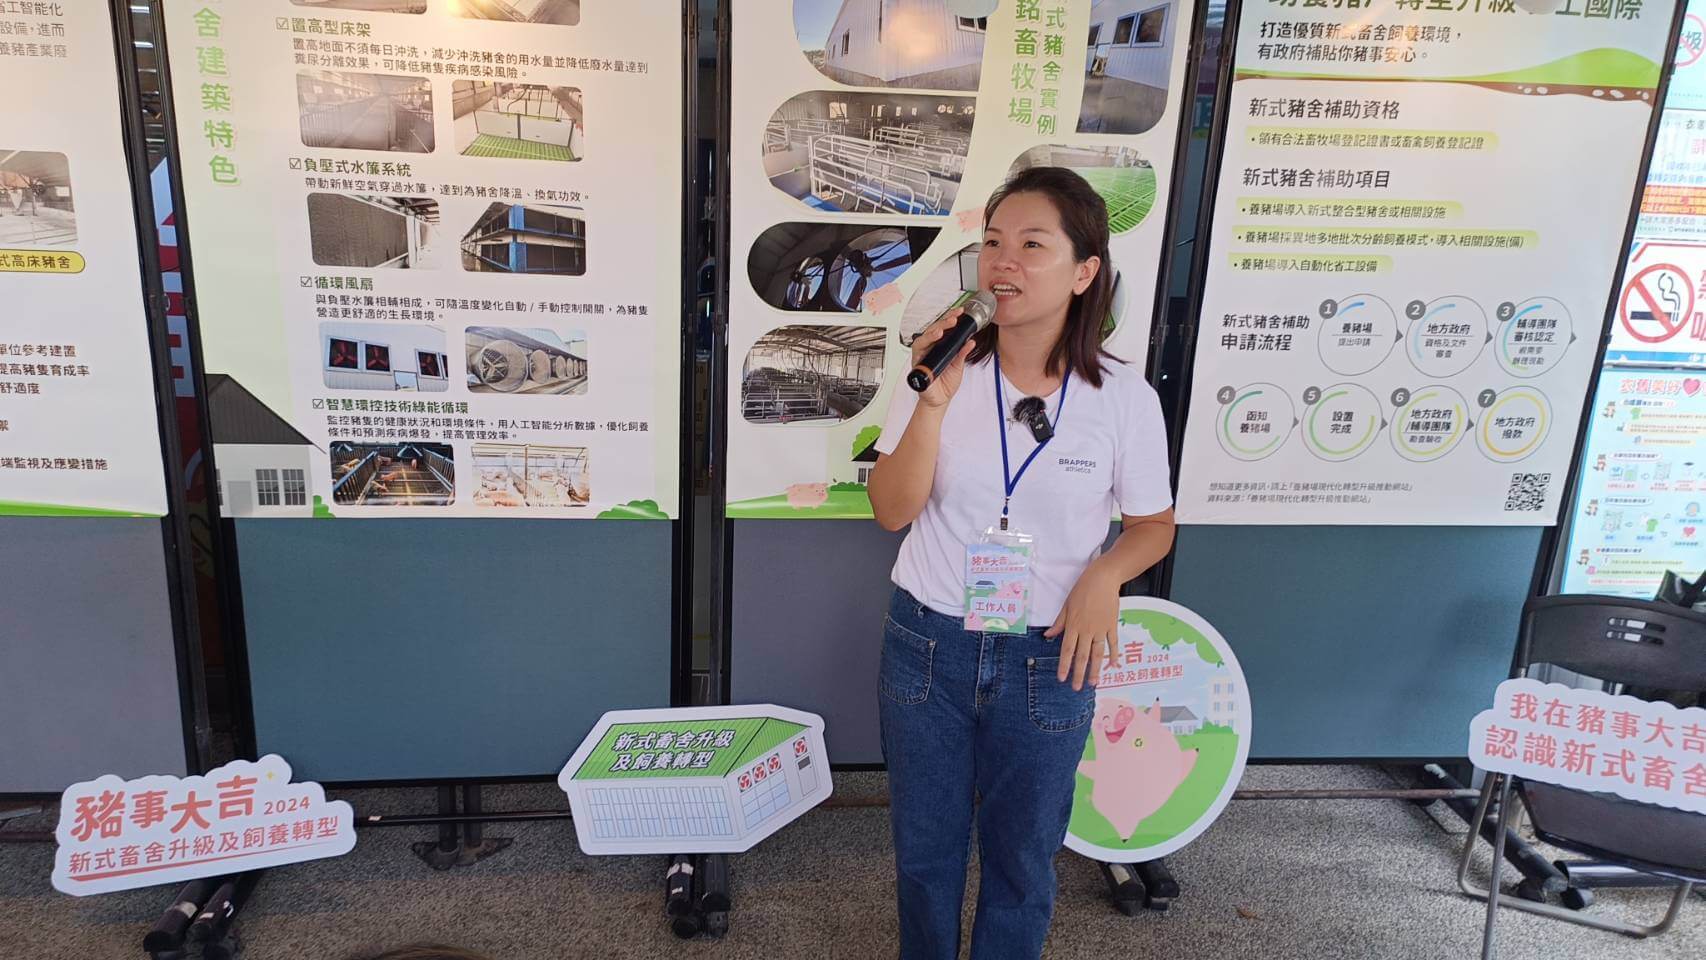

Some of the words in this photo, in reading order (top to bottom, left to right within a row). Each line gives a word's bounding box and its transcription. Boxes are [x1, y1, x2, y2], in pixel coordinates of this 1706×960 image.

[292, 17, 371, 36] 置高型床架
[1256, 43, 1429, 62] 有政府補貼你豬事安心。
[1037, 6, 1065, 135] 式豬舍實例
[194, 7, 238, 186] 舍建築特色
[1249, 97, 1400, 119] 新式豬舍補助資格
[304, 158, 412, 177] 負壓式水簾系統
[1243, 167, 1391, 188] 新式豬舍補助項目
[315, 276, 374, 291] 循環風扇
[1325, 303, 1332, 315] 1
[1411, 304, 1421, 316] 2
[1502, 306, 1510, 319] 3
[1222, 314, 1310, 330] 新式豬舍補助
[1341, 322, 1373, 334] 養豬場
[1427, 323, 1471, 335] 地方政府
[1221, 333, 1292, 351] 申請流程
[1221, 390, 1231, 402] 4
[1308, 390, 1318, 402] 5
[1396, 391, 1404, 403] 6
[1482, 392, 1492, 405] 7
[326, 398, 469, 415] 智慧環控技術綠能循環
[1411, 409, 1452, 420] 地方政府
[1332, 411, 1354, 422] 設置
[1495, 417, 1535, 428] 地方政府
[975, 600, 1017, 614] 工作人員
[1147, 653, 1169, 664] 2024
[1510, 692, 1706, 754] 我在豬事大吉
[612, 729, 737, 757] 新式畜舍升級
[608, 749, 716, 773] 及飼養轉型
[1483, 724, 1706, 798] 認識新式畜舍
[70, 775, 258, 842] 豬事大吉
[263, 796, 311, 816] 2024
[68, 815, 340, 873] 新式畜舍升級及飼養轉型
